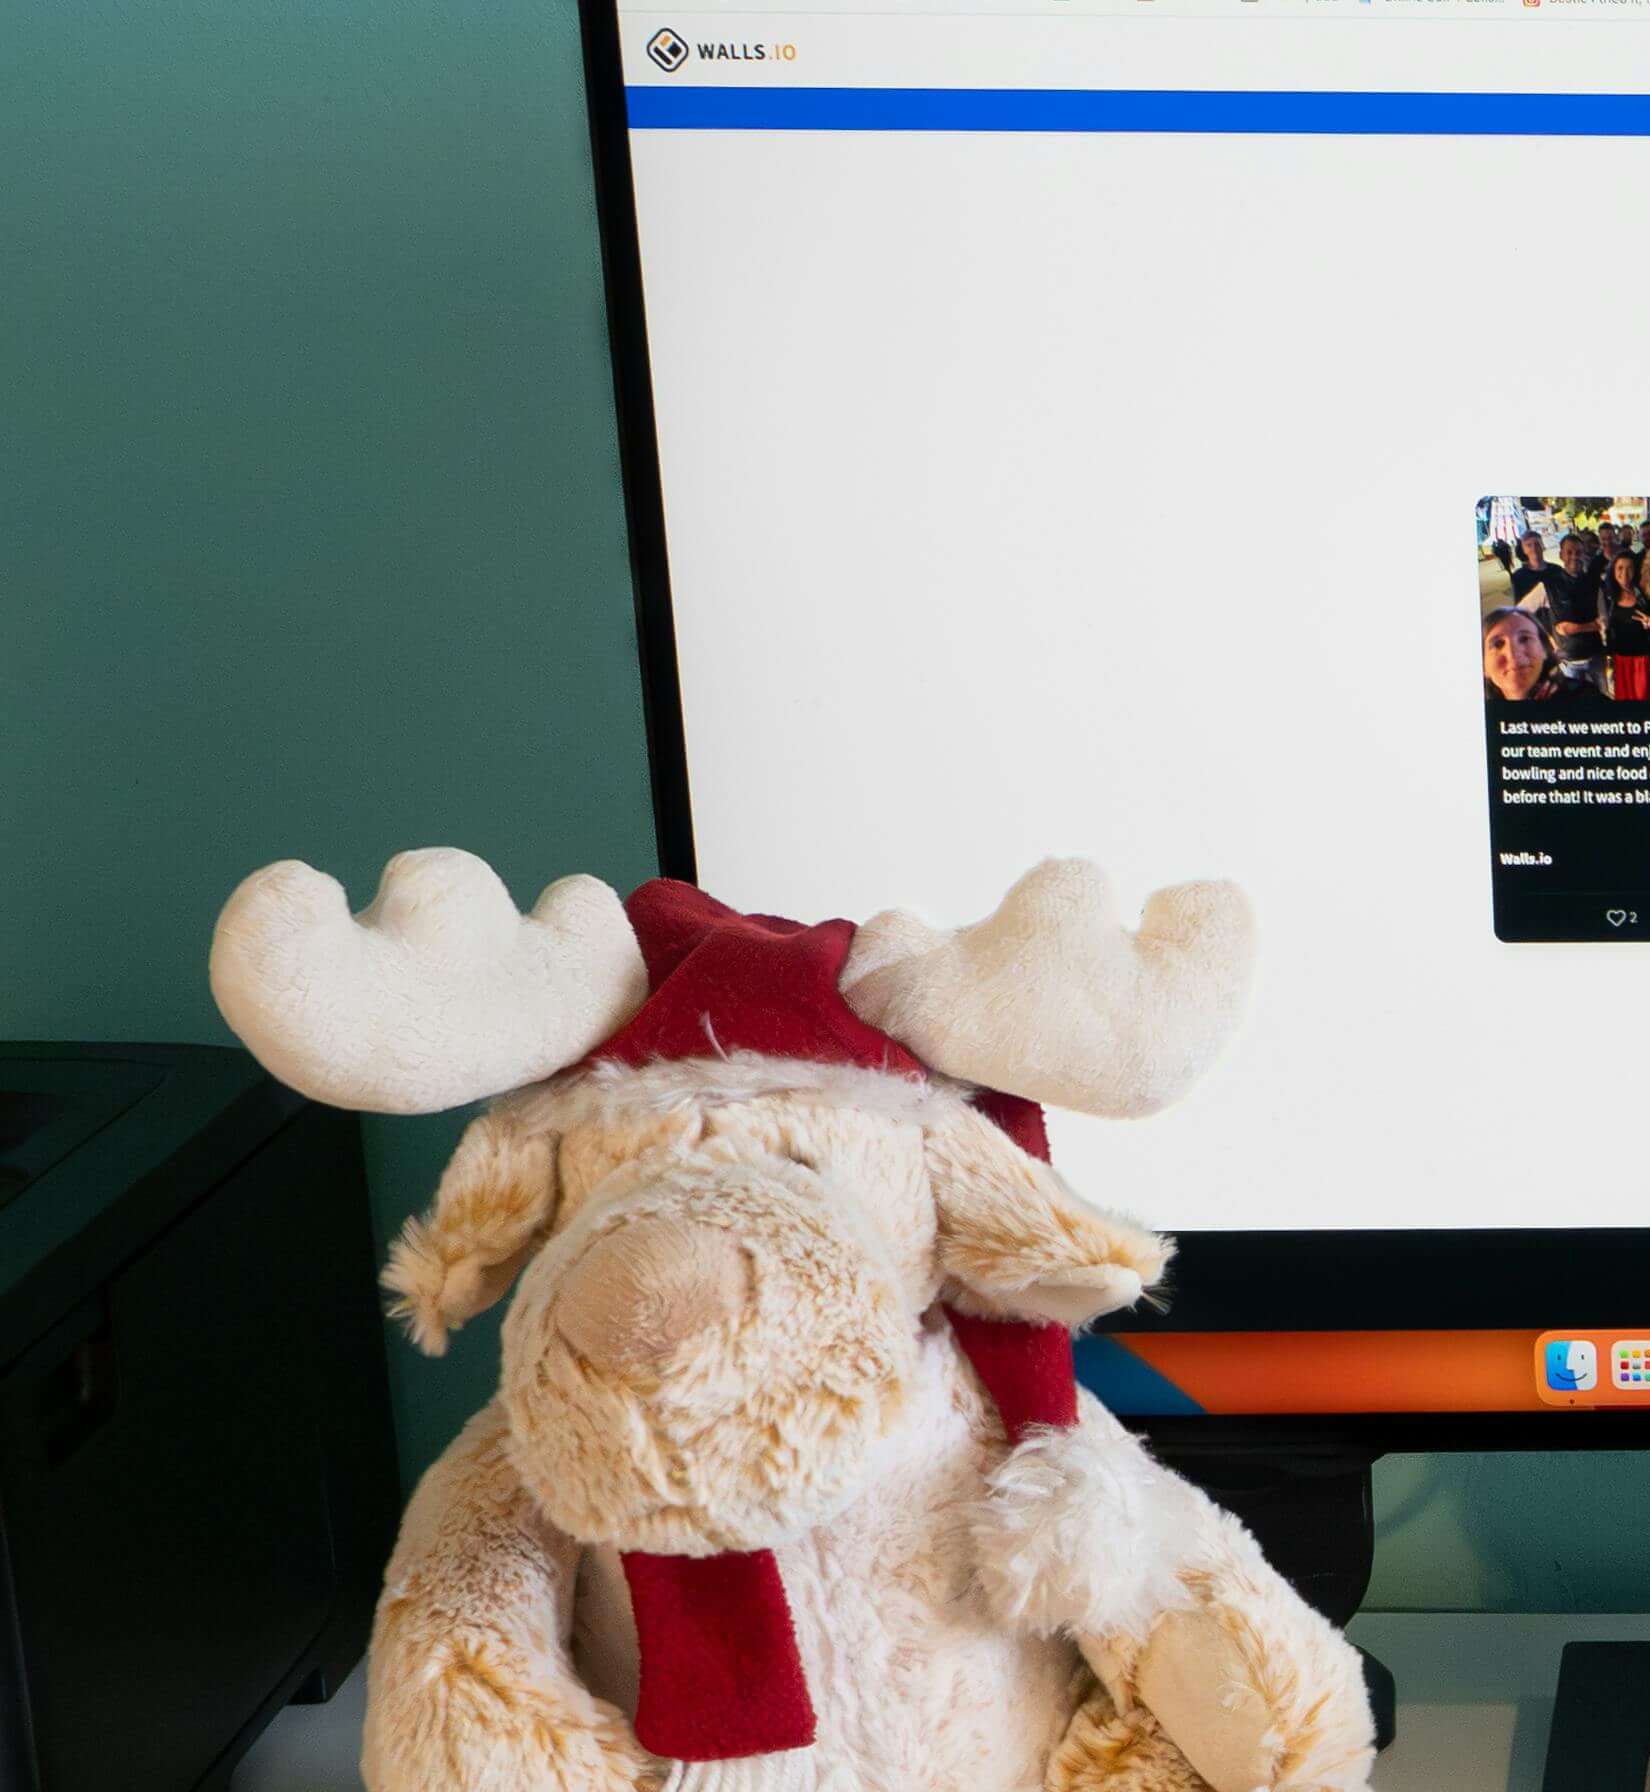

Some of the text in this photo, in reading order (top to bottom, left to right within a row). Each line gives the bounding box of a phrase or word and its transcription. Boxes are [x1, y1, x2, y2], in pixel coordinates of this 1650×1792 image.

[697, 43, 779, 61] WALLS.IO
[1499, 721, 1530, 735] Last
[1530, 720, 1567, 735] week
[1567, 722, 1589, 735] we
[1589, 721, 1625, 735] went
[1626, 721, 1642, 735] to
[1500, 746, 1526, 758] our
[1526, 745, 1562, 758] team
[1563, 745, 1603, 758] event
[1603, 743, 1630, 758] and
[1502, 766, 1557, 784] bowling
[1557, 766, 1585, 781] and
[1586, 766, 1615, 781] nice
[1616, 765, 1648, 780] food
[1503, 789, 1547, 804] before
[1548, 789, 1581, 804] that!
[1583, 790, 1594, 804] It
[1594, 791, 1623, 804] was
[1623, 792, 1634, 804] a
[1500, 852, 1552, 865] Walls.io
